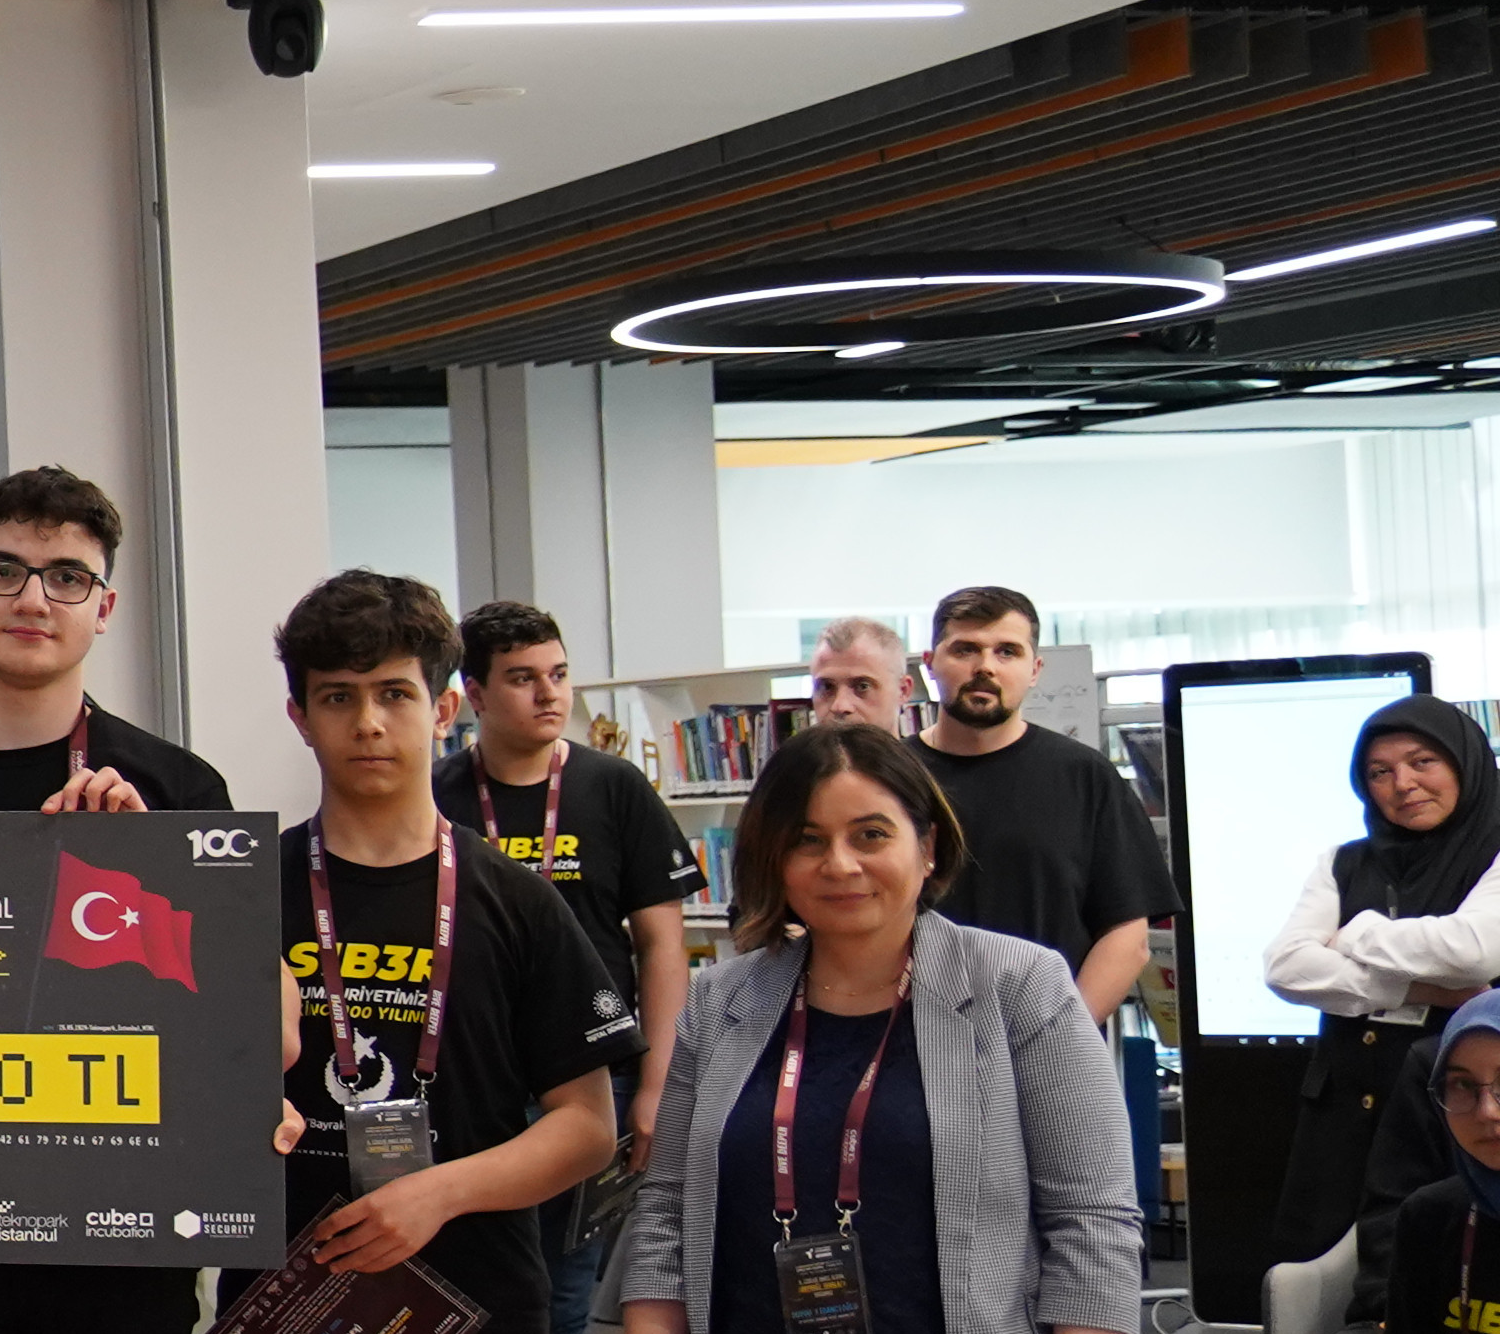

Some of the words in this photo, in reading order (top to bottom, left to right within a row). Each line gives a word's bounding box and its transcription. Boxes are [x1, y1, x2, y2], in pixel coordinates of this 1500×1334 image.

[289, 941, 434, 983] SB3R
[67, 1054, 141, 1106] TL
[86, 1209, 137, 1226] cube
[202, 1213, 256, 1223] BLACKBOX
[85, 1225, 154, 1239] incubation
[203, 1224, 255, 1235] SECURITY
